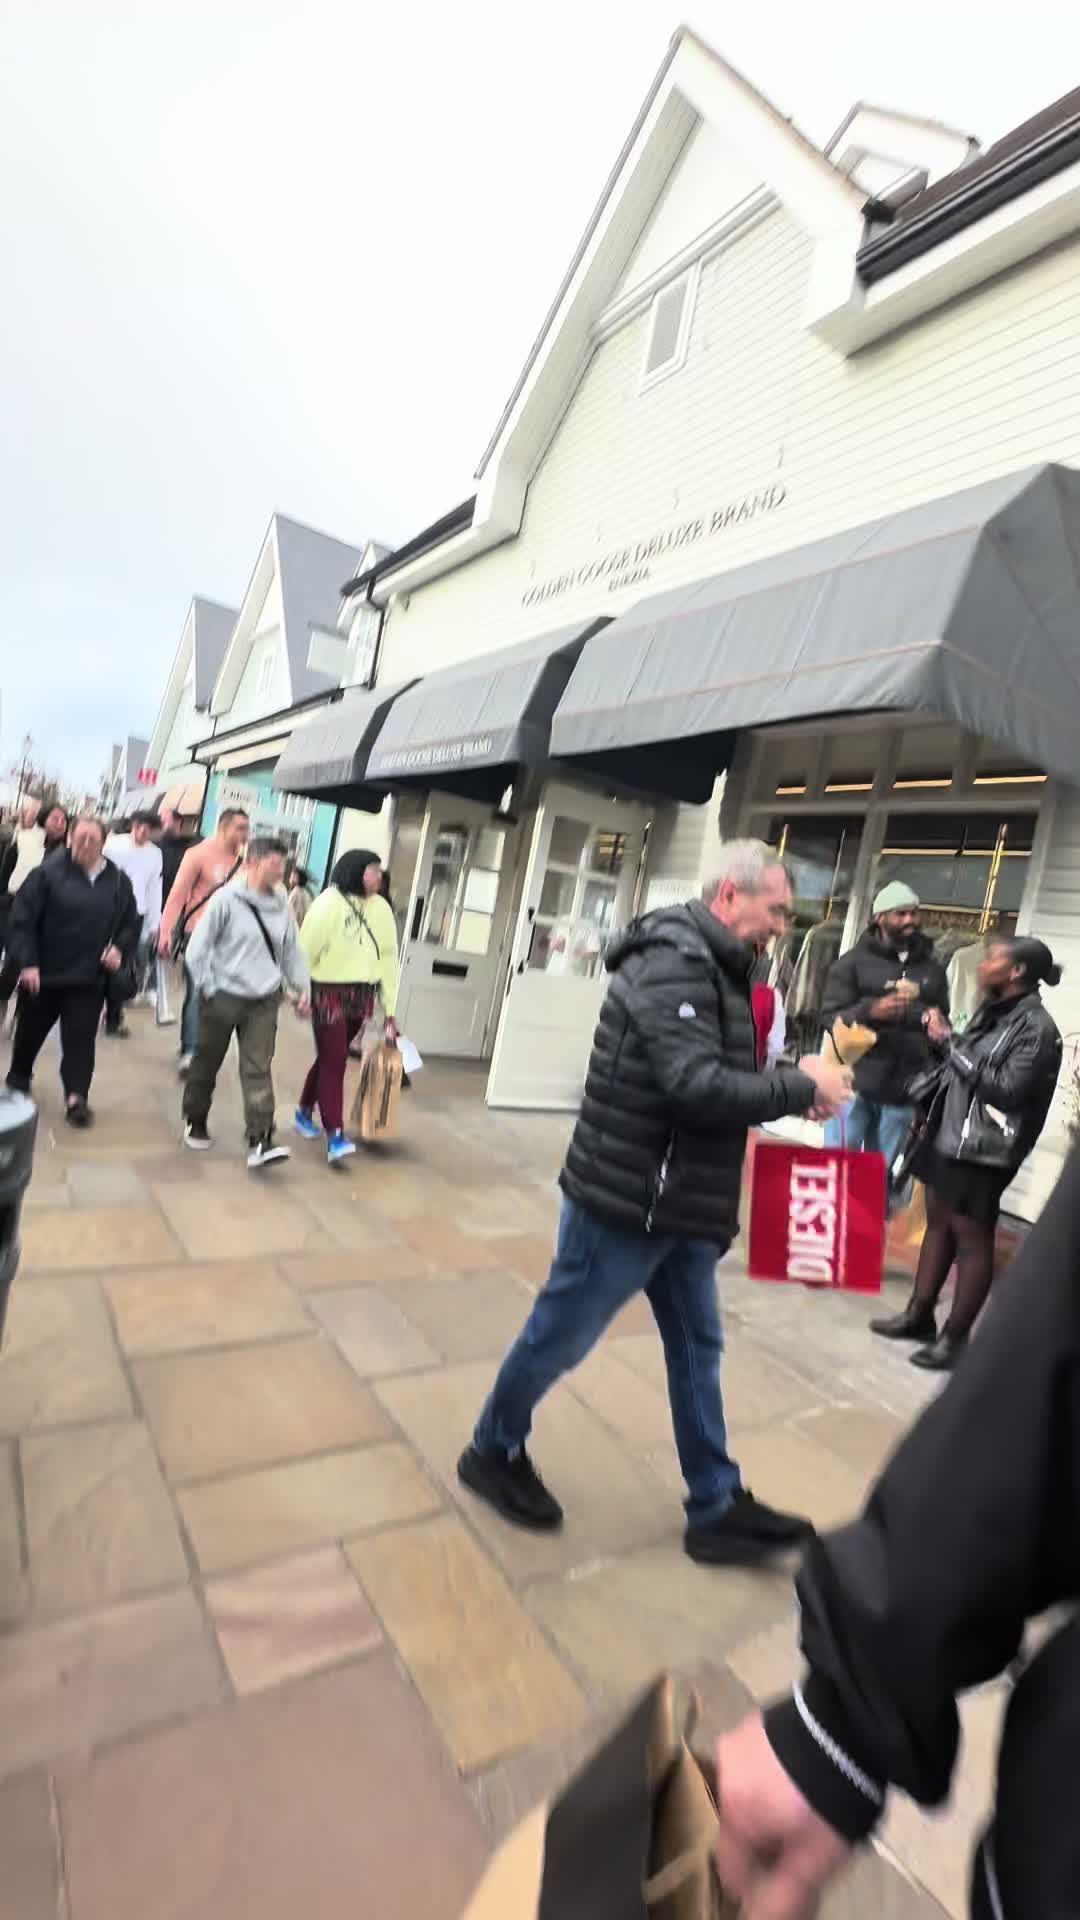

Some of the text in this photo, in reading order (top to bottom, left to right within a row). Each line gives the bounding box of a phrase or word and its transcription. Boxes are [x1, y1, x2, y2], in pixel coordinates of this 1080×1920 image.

[634, 519, 704, 564] DELUXE
[709, 486, 787, 535] BRAND
[786, 1158, 838, 1282] DIESEL
